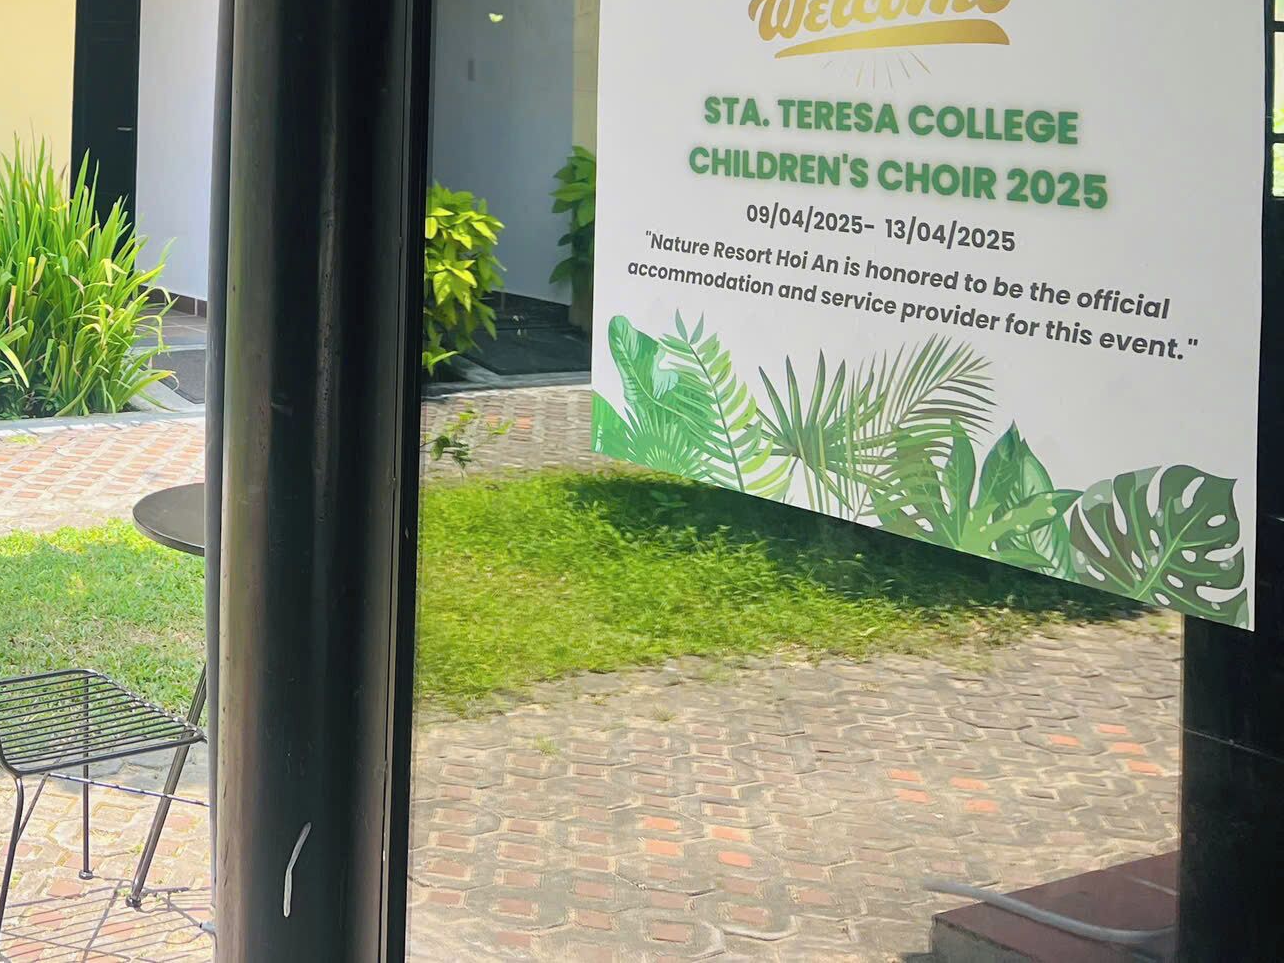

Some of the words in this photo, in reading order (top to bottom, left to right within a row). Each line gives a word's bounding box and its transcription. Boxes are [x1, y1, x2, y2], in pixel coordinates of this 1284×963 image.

[703, 95, 771, 127] STA.
[777, 99, 900, 135] TERESA
[907, 104, 1079, 145] COLLEGE
[688, 146, 869, 188] CHILDREN'S
[877, 160, 997, 200] CHOIR
[1006, 168, 1108, 210] 2025
[885, 216, 1017, 252] 13/04/2025
[645, 230, 710, 256] "Nature
[713, 241, 773, 265] Resort
[776, 249, 809, 270] Hoi
[811, 254, 839, 274] An
[843, 255, 860, 277] is
[865, 260, 959, 291] honored
[964, 273, 988, 294] to
[993, 276, 1024, 299] be
[1029, 282, 1071, 306] the
[1076, 288, 1171, 320] official
[627, 260, 774, 296] accommodation
[778, 284, 817, 303] and
[820, 291, 897, 315] service
[900, 301, 1000, 331] provider
[1005, 312, 1040, 338] for
[1045, 319, 1093, 346] this
[1099, 331, 1199, 360] event."
